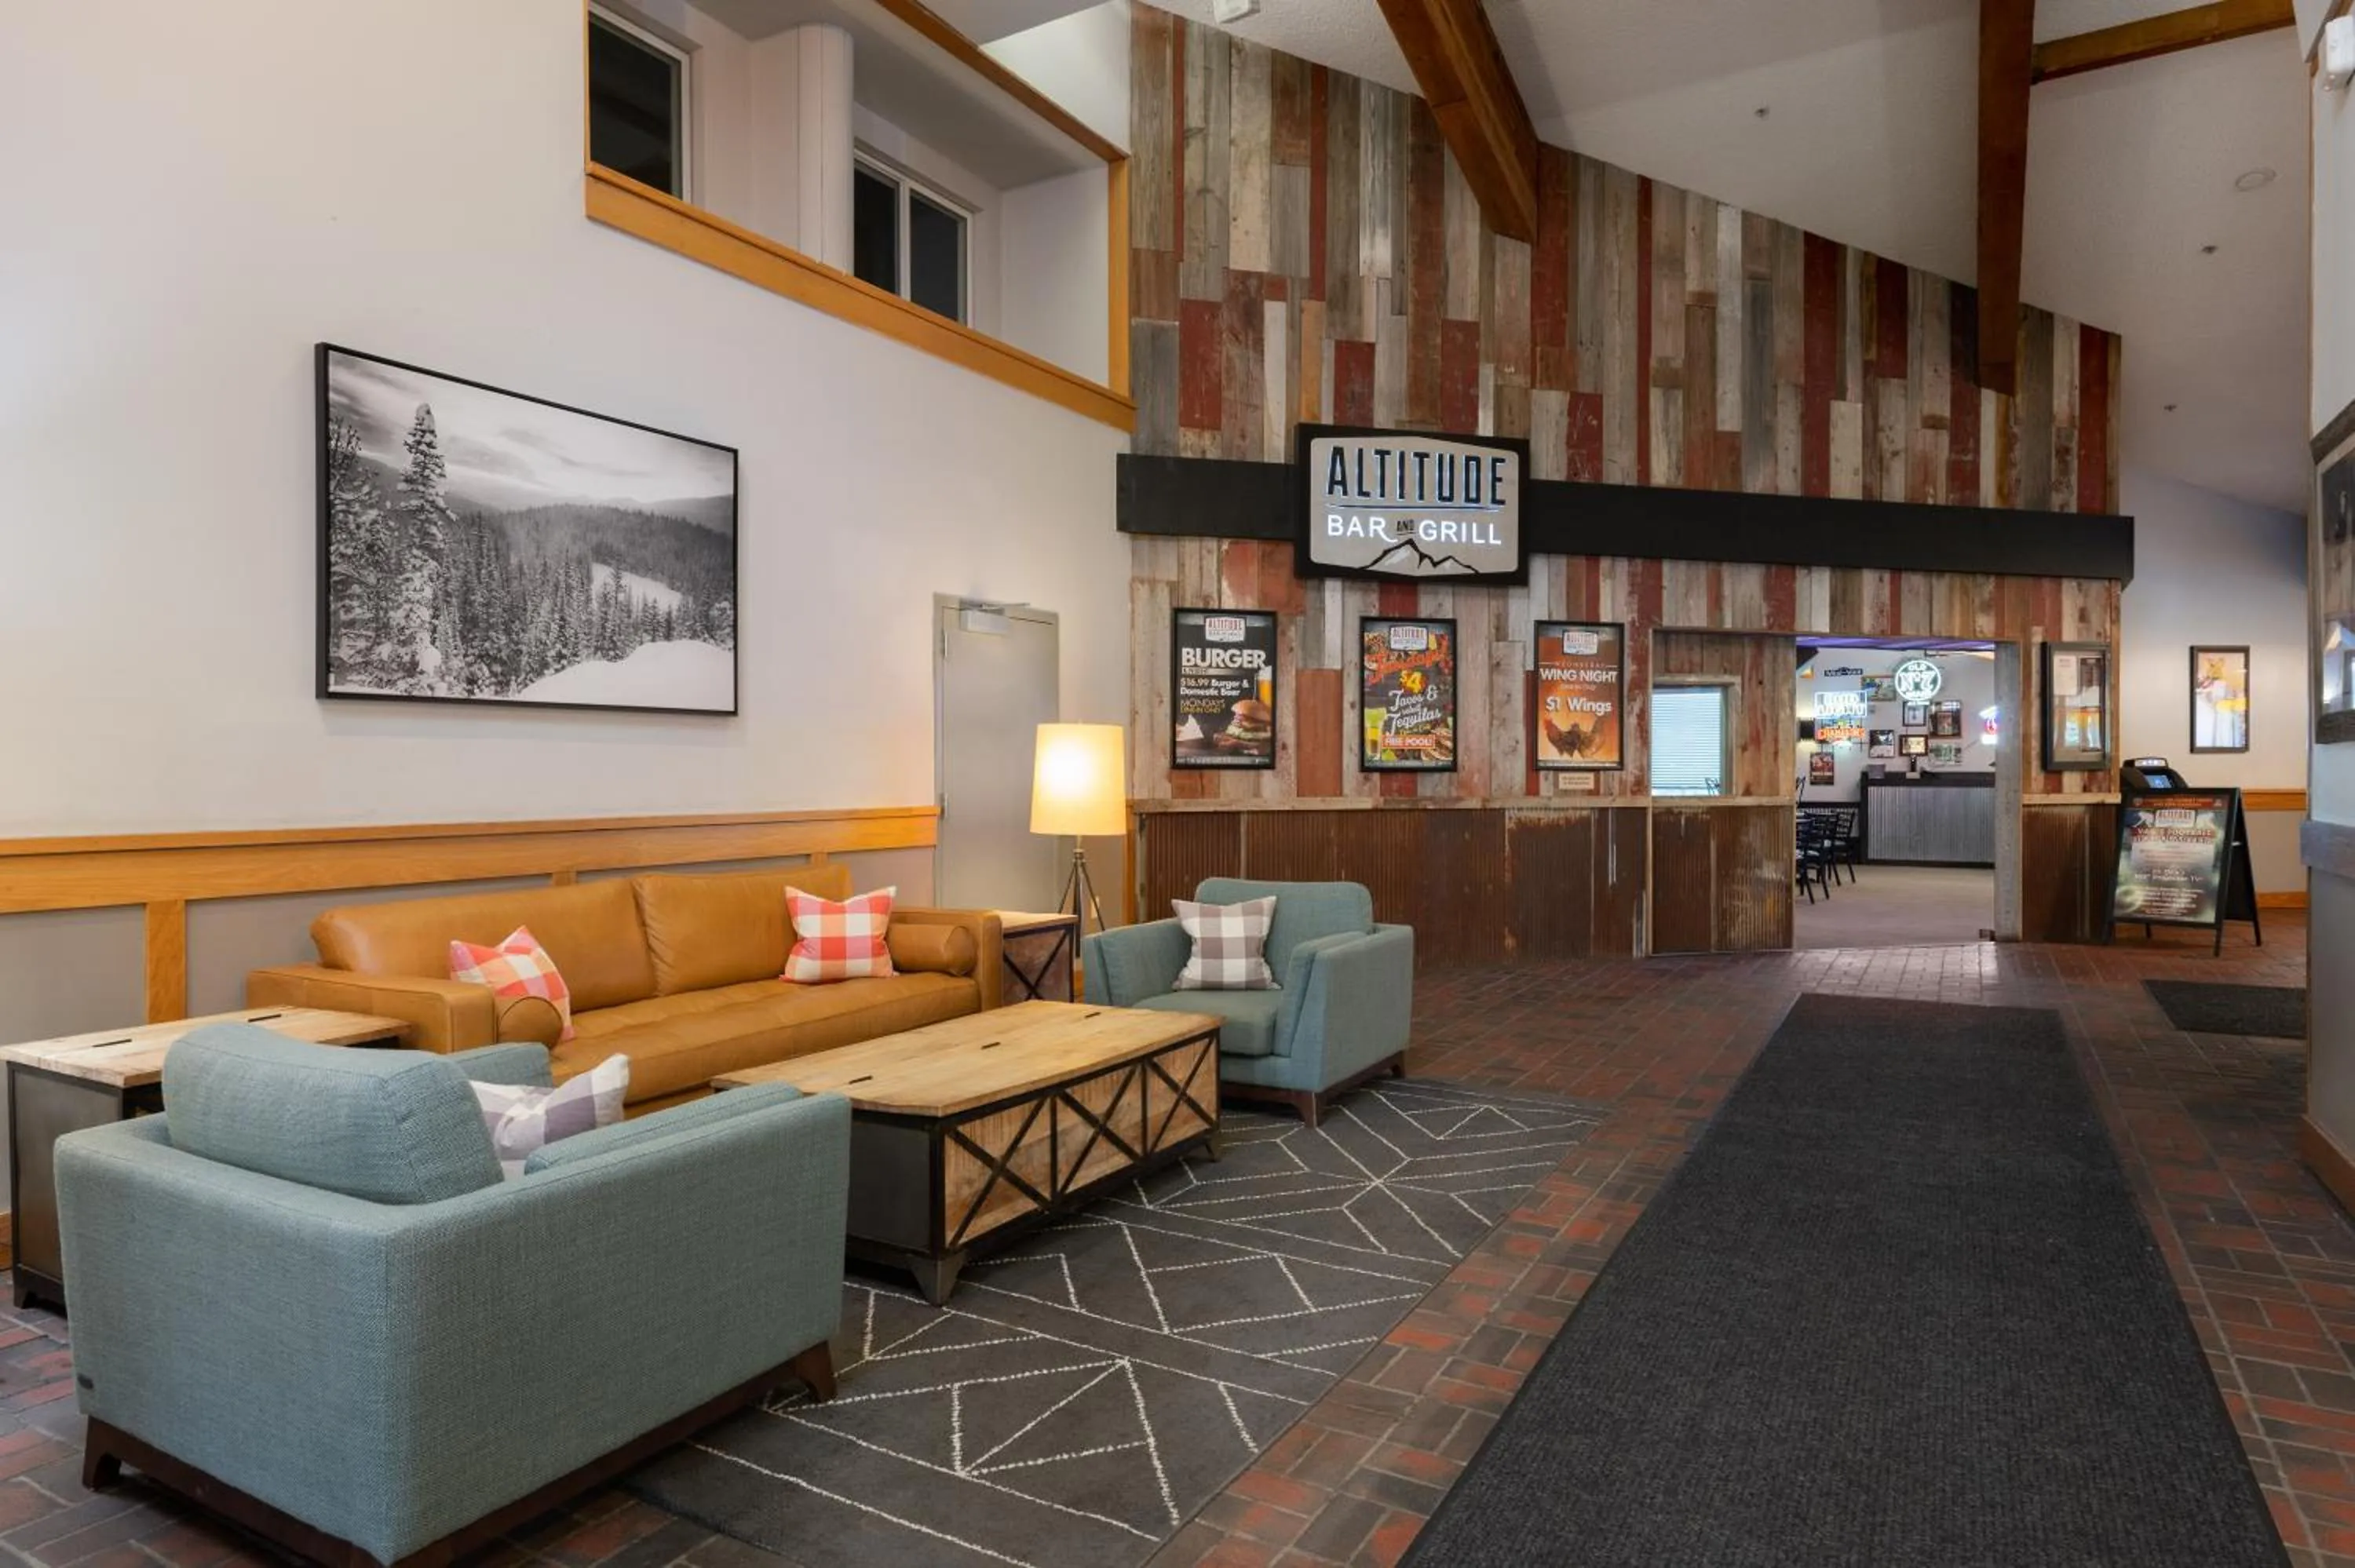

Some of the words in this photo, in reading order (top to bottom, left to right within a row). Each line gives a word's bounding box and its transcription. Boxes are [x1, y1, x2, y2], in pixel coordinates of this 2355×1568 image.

[1327, 446, 1506, 505] ALTITUDE
[1327, 514, 1398, 542] BAR
[1397, 519, 1415, 531] AND
[1418, 520, 1502, 545] GRILL
[1181, 647, 1266, 669] BURGER
[1211, 679, 1240, 689] Burger
[1243, 679, 1250, 687] &
[1539, 667, 1577, 680] WING
[1579, 669, 1618, 683] NIGHT
[1180, 687, 1219, 695] Domestic
[1388, 688, 1424, 711] Tacos
[1426, 684, 1438, 700] &
[1568, 696, 1612, 716] Wings
[1386, 708, 1443, 736] Tequilas
